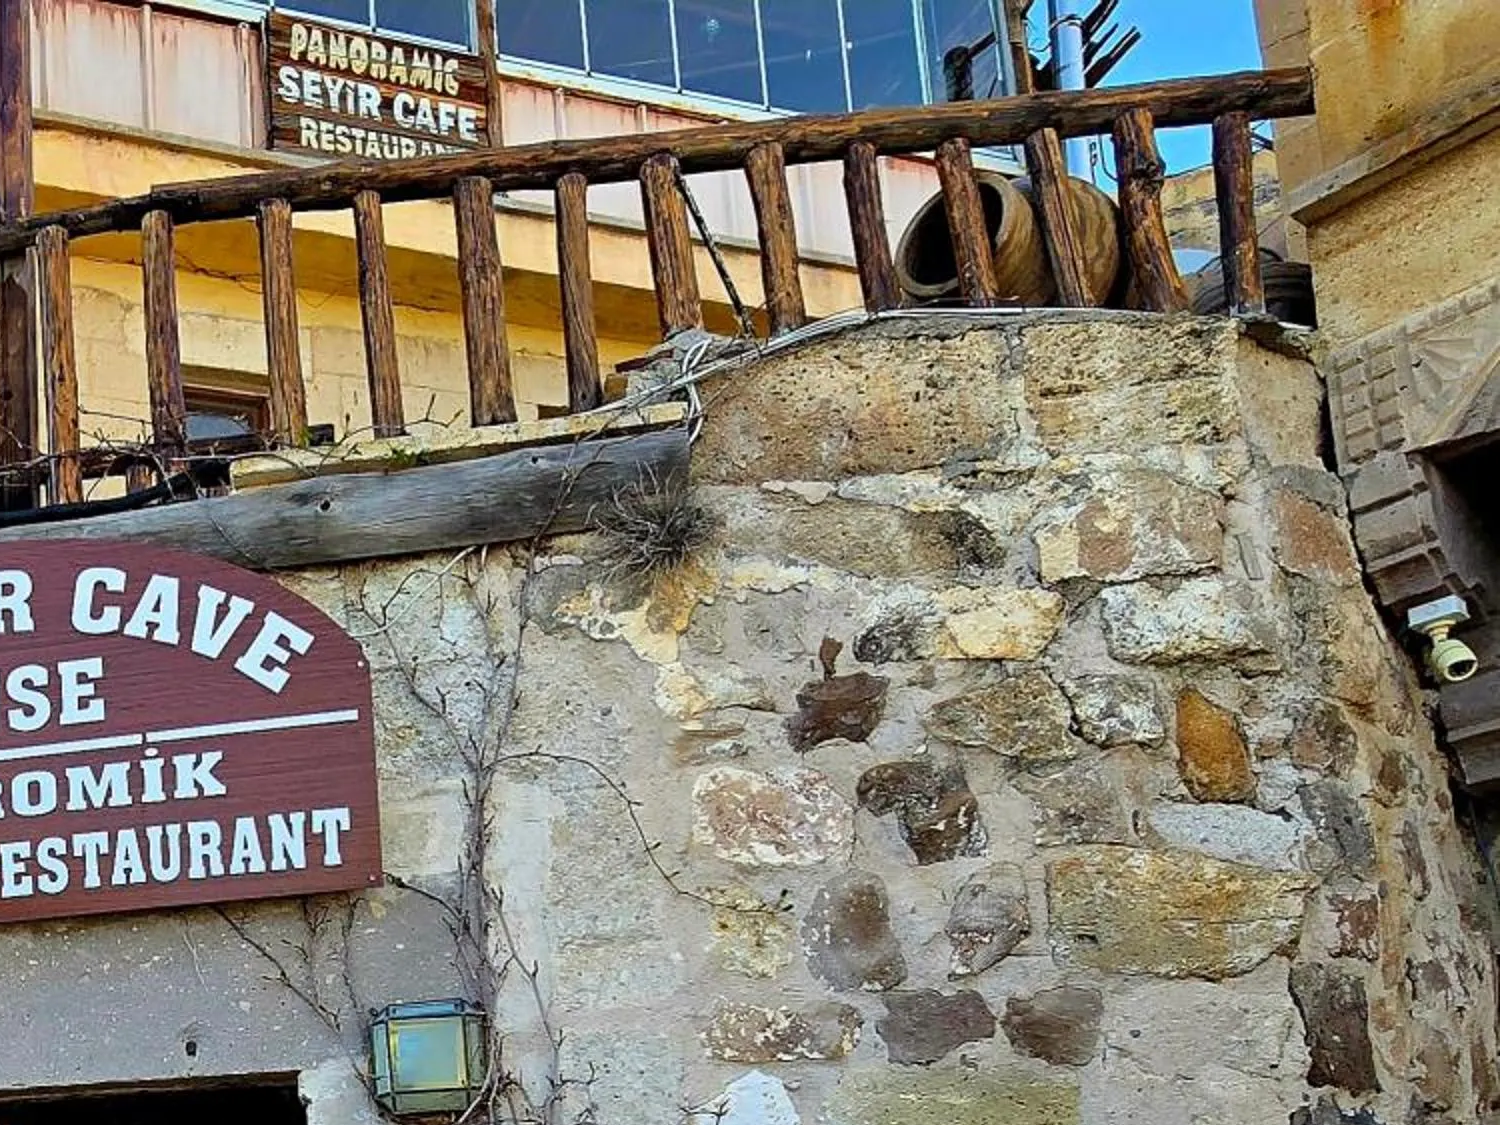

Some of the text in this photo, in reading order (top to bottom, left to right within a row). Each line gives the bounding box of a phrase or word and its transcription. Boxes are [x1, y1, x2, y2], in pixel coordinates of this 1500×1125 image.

[290, 23, 459, 96] PANORAMIC
[300, 116, 466, 160] RESTAURA
[393, 92, 480, 142] CAFE
[71, 567, 315, 693] CAVE
